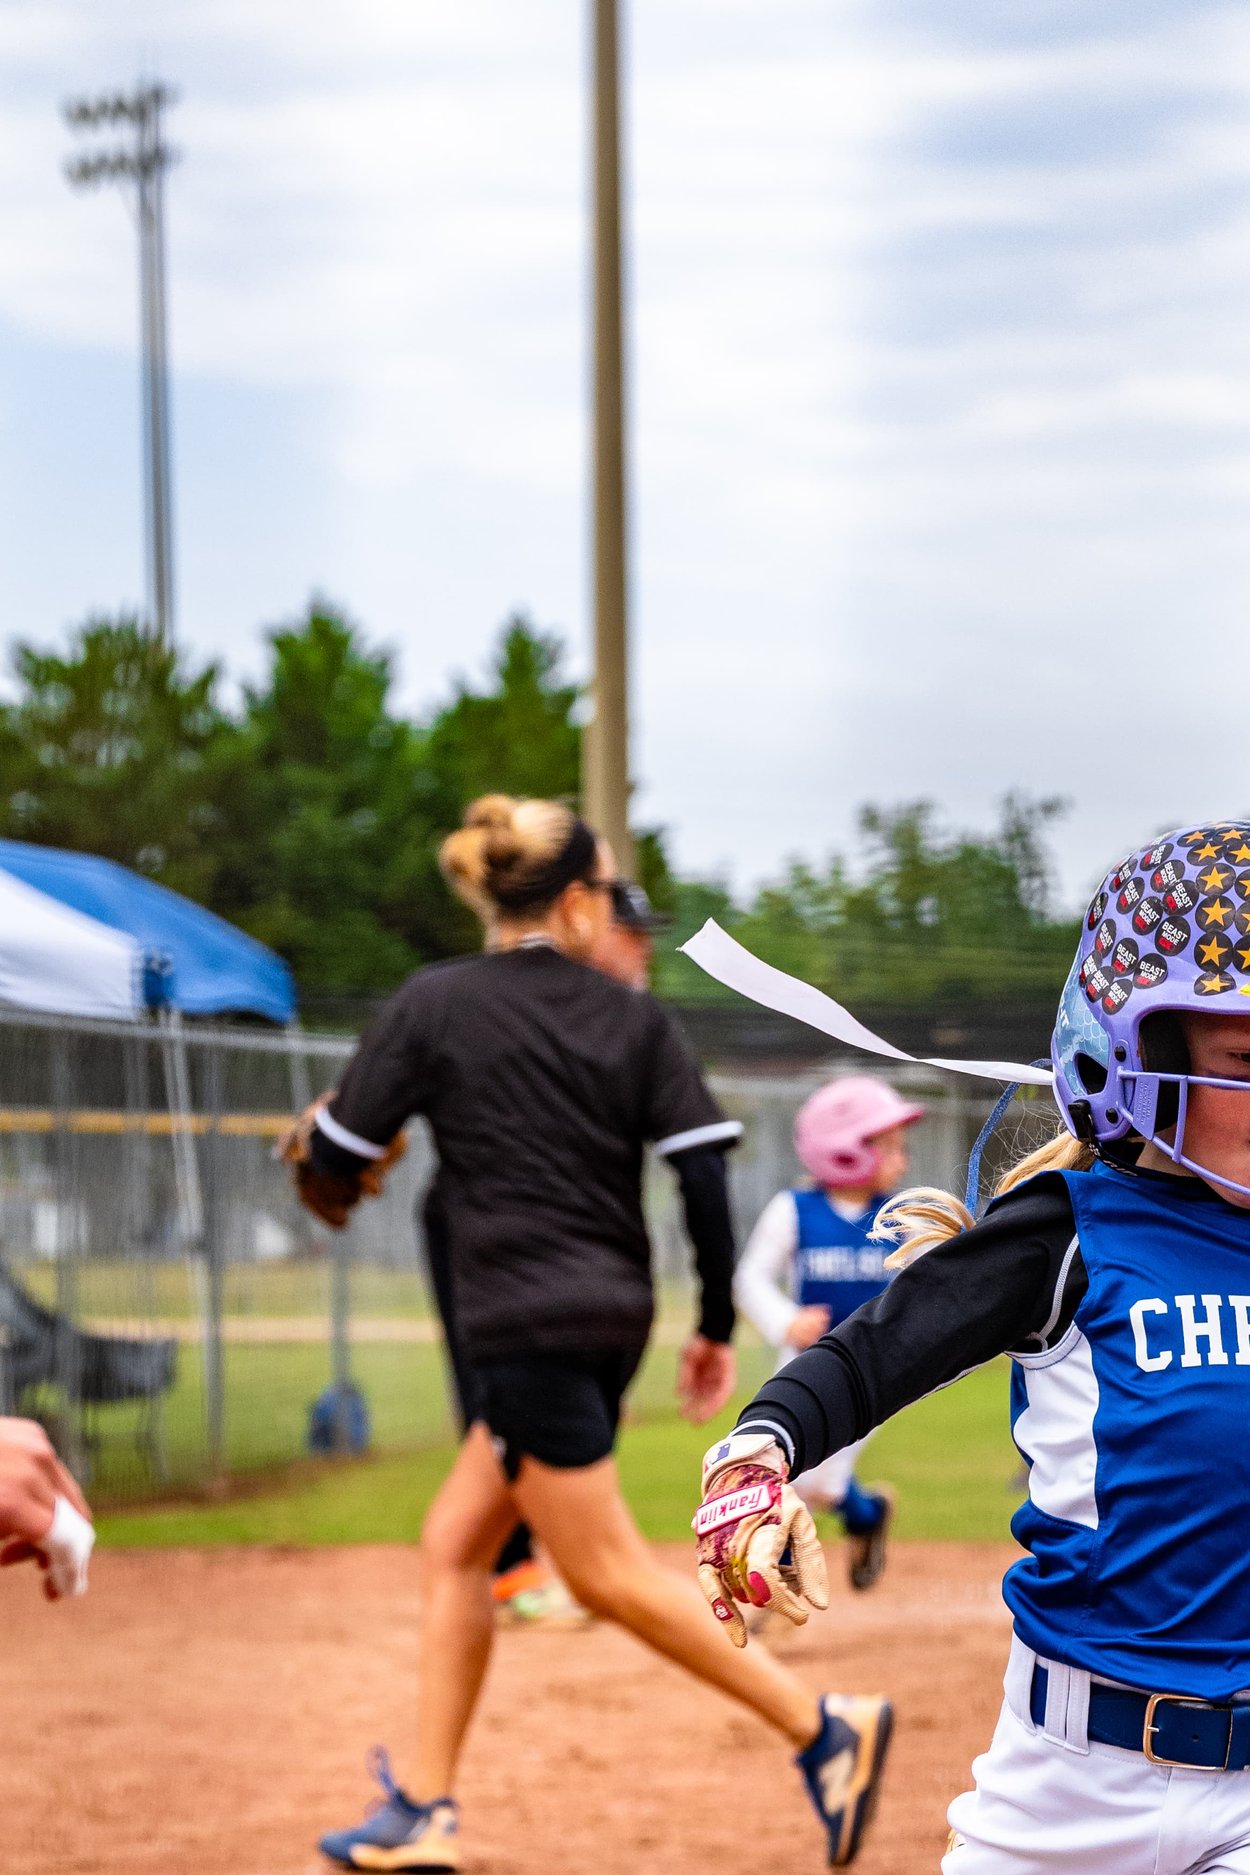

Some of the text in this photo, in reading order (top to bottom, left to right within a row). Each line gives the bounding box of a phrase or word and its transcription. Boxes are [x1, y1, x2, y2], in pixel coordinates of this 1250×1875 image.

[1127, 881, 1139, 901] BEAST
[1171, 890, 1183, 909] MODE
[1175, 882, 1192, 908] BEAST
[1141, 900, 1160, 922] BEAST
[1162, 921, 1188, 942] BEAST
[1162, 931, 1180, 945] MODE
[1116, 953, 1130, 968] MODE
[1117, 944, 1137, 964] BEAST
[1140, 961, 1165, 977] BEAST
[1140, 971, 1157, 981] MODE
[1094, 970, 1109, 989] BEAST
[1110, 982, 1127, 1001] BEAST
